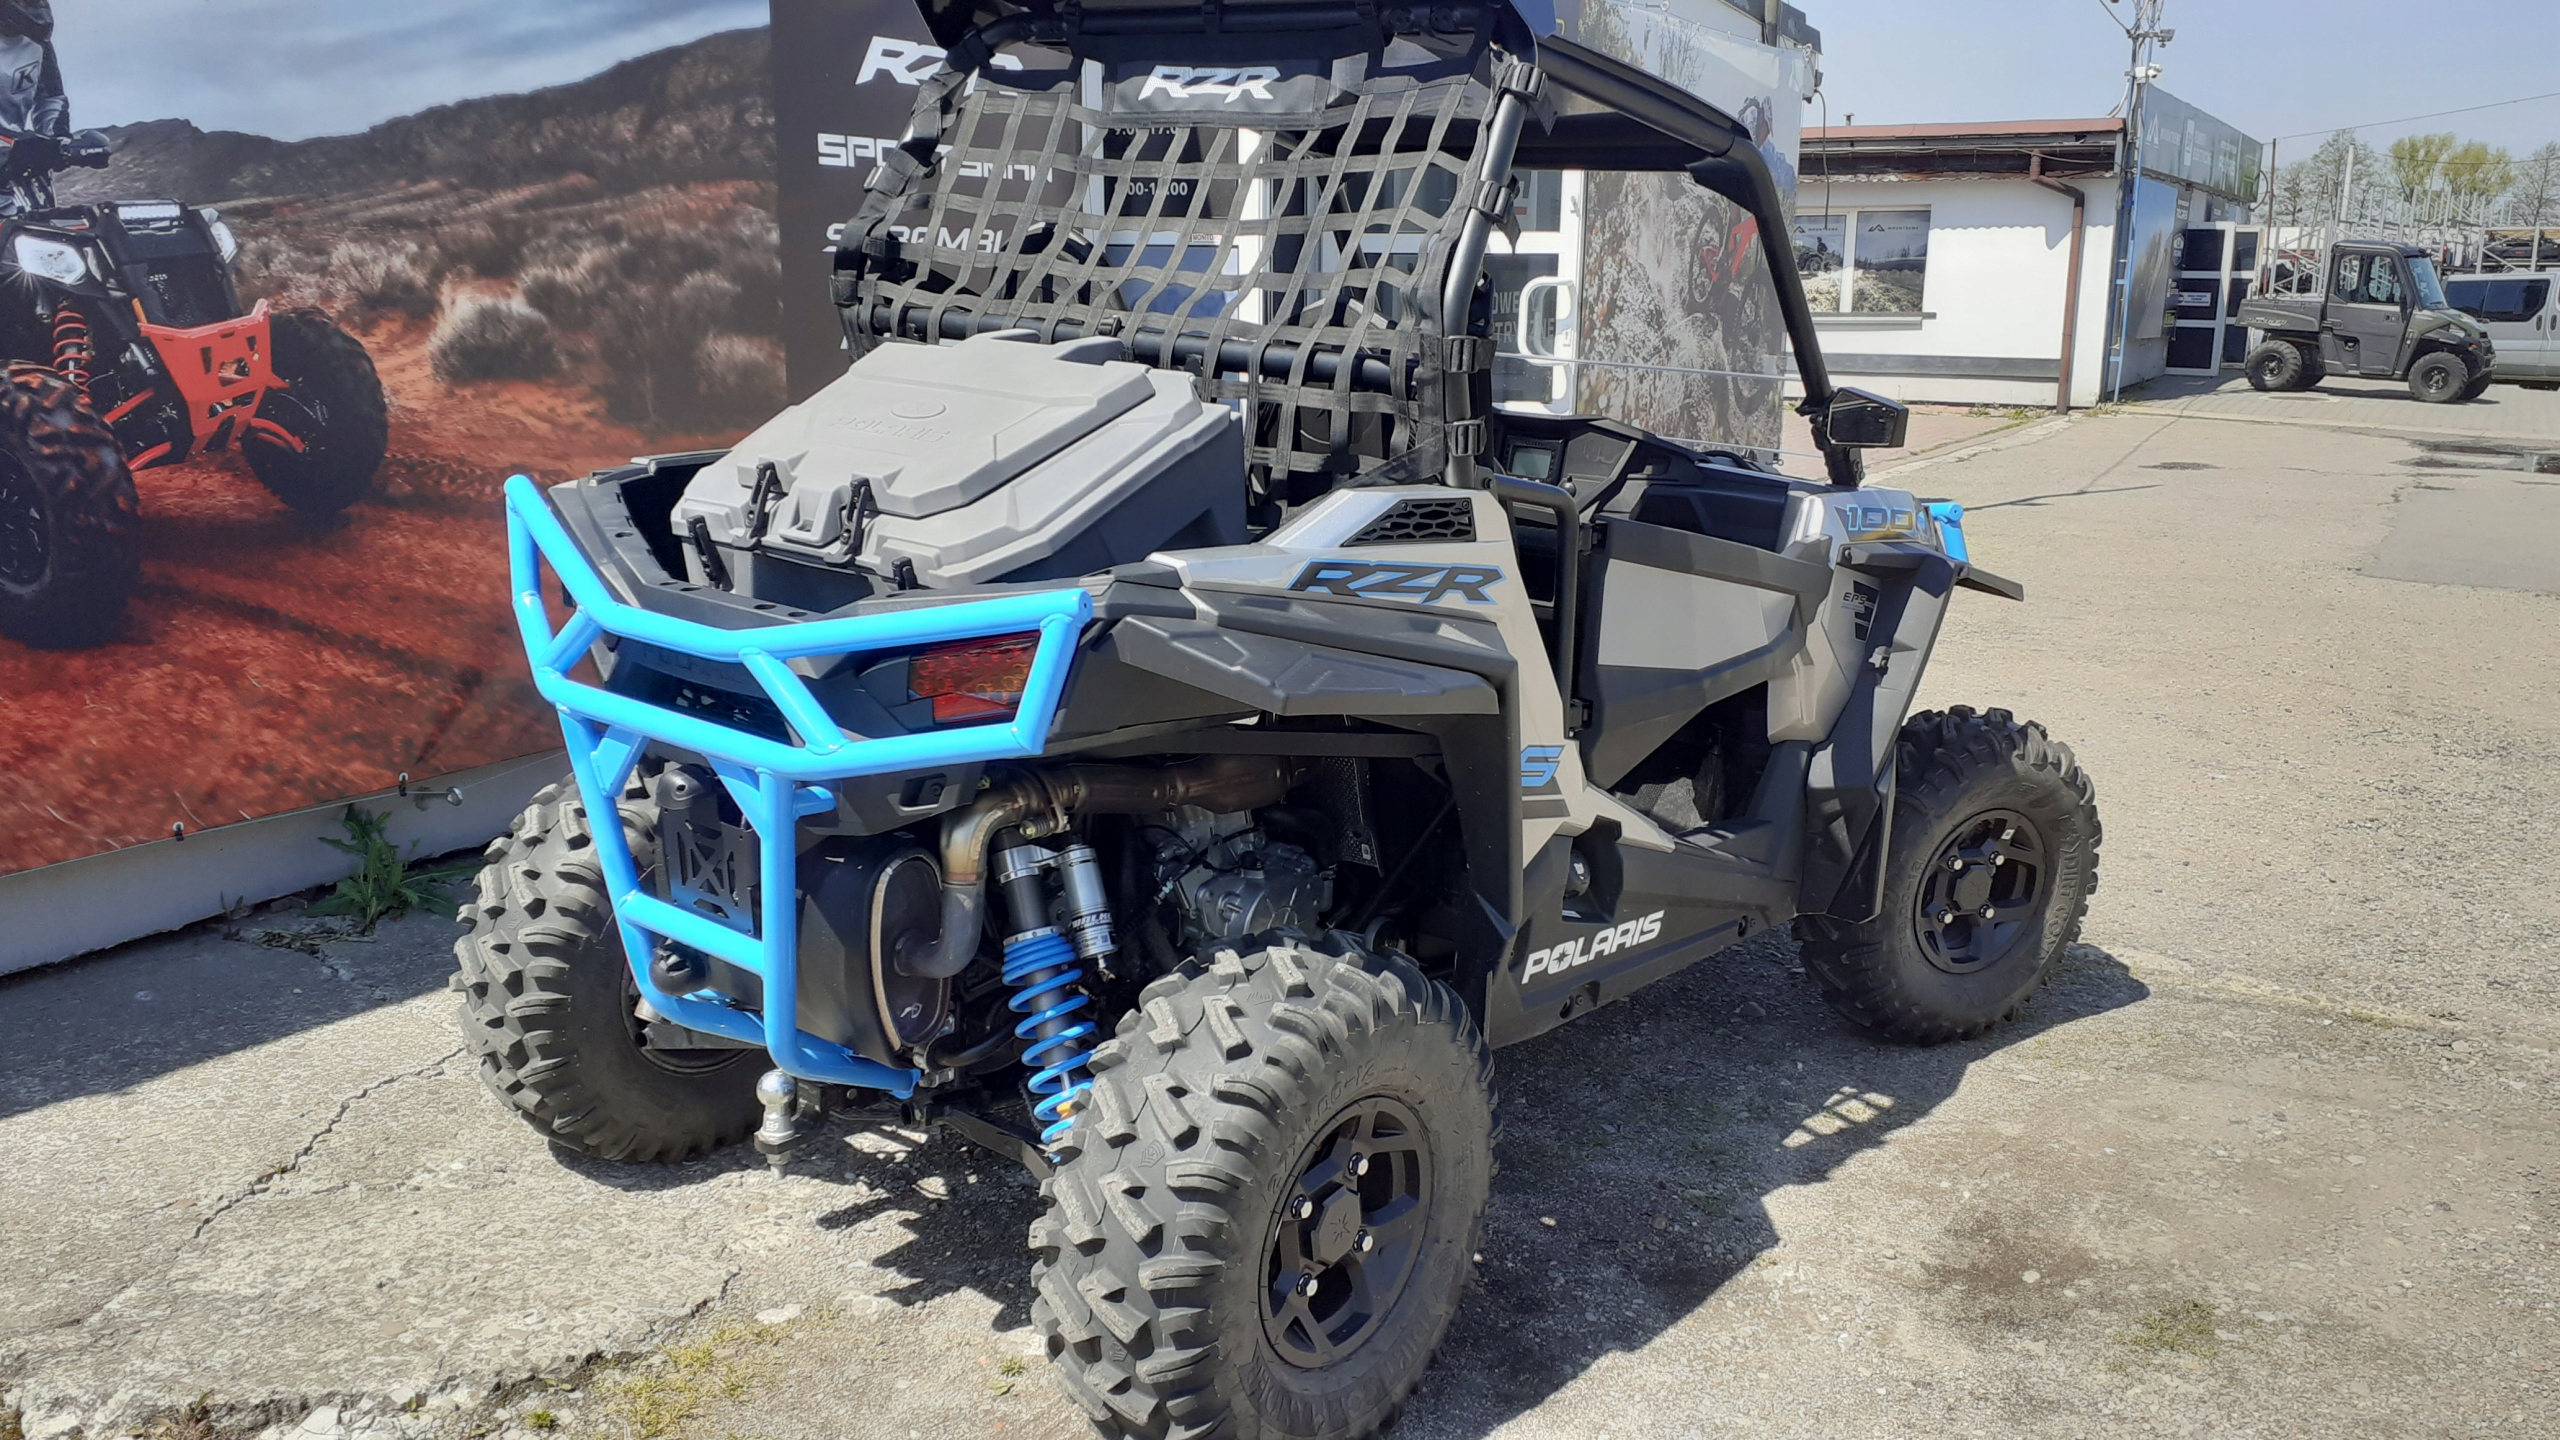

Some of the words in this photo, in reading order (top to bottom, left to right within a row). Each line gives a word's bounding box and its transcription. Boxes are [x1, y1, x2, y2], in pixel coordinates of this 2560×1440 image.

[1138, 65, 1281, 104] RZR
[1115, 182, 1188, 196] 00-1.00
[1286, 557, 1507, 605] RZR
[1842, 591, 1867, 605] EPS
[1520, 744, 1565, 787] S
[1521, 909, 1665, 985] POLARIS
